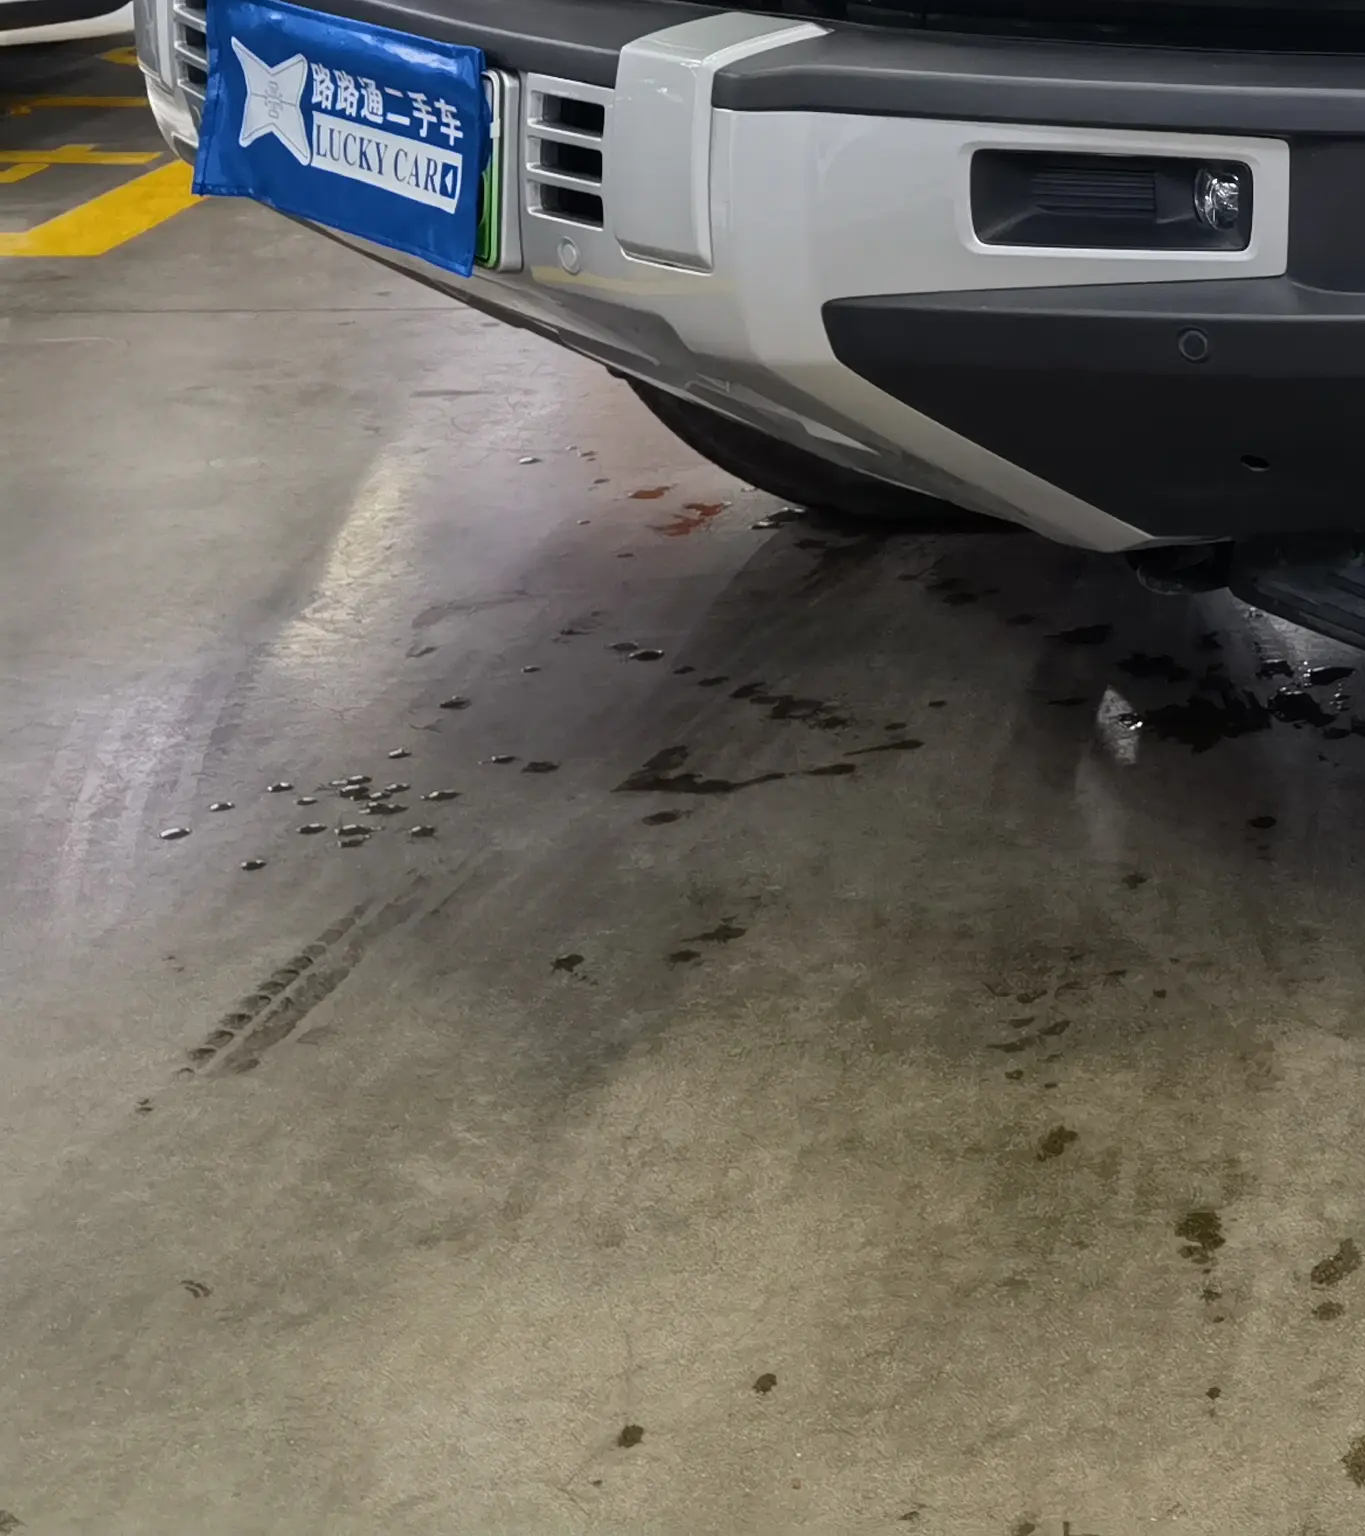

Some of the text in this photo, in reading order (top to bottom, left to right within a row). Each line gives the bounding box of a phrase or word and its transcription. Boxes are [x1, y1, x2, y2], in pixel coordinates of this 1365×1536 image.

[310, 62, 464, 147] 路路通二手车
[315, 123, 438, 194] LUCKY CAR
